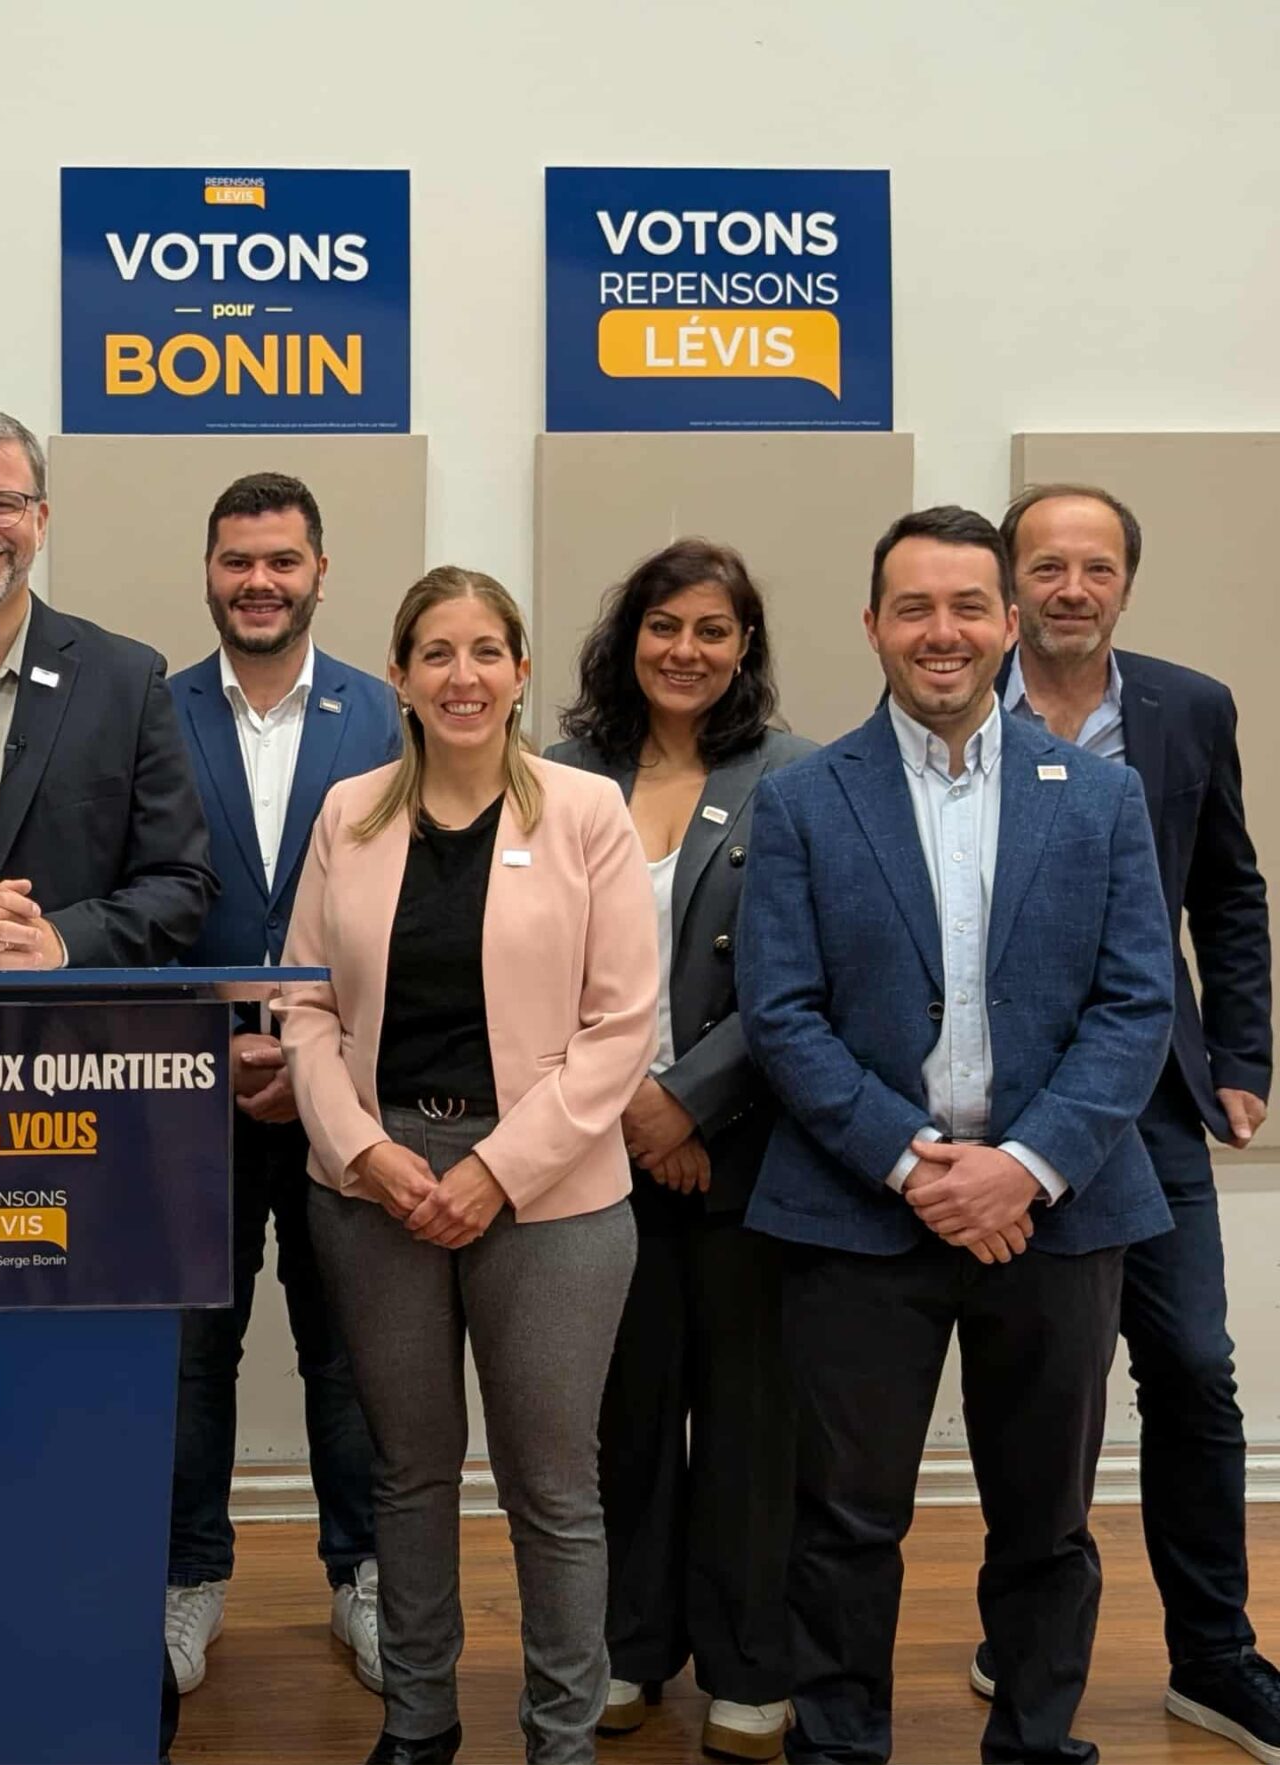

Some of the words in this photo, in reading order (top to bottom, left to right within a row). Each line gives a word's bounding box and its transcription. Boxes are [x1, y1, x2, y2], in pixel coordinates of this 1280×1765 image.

[204, 177, 265, 187] REPENSONS
[596, 210, 838, 256] VOTONS
[105, 232, 369, 281] VOTONS
[600, 271, 840, 306] REPENSONS
[212, 302, 255, 319] pour
[645, 315, 795, 368] LÉVIS
[105, 334, 362, 396] BONIN
[33, 1052, 216, 1097] QUARTIERS
[10, 1111, 98, 1150] VOUS
[33, 1254, 67, 1266] Bonin
